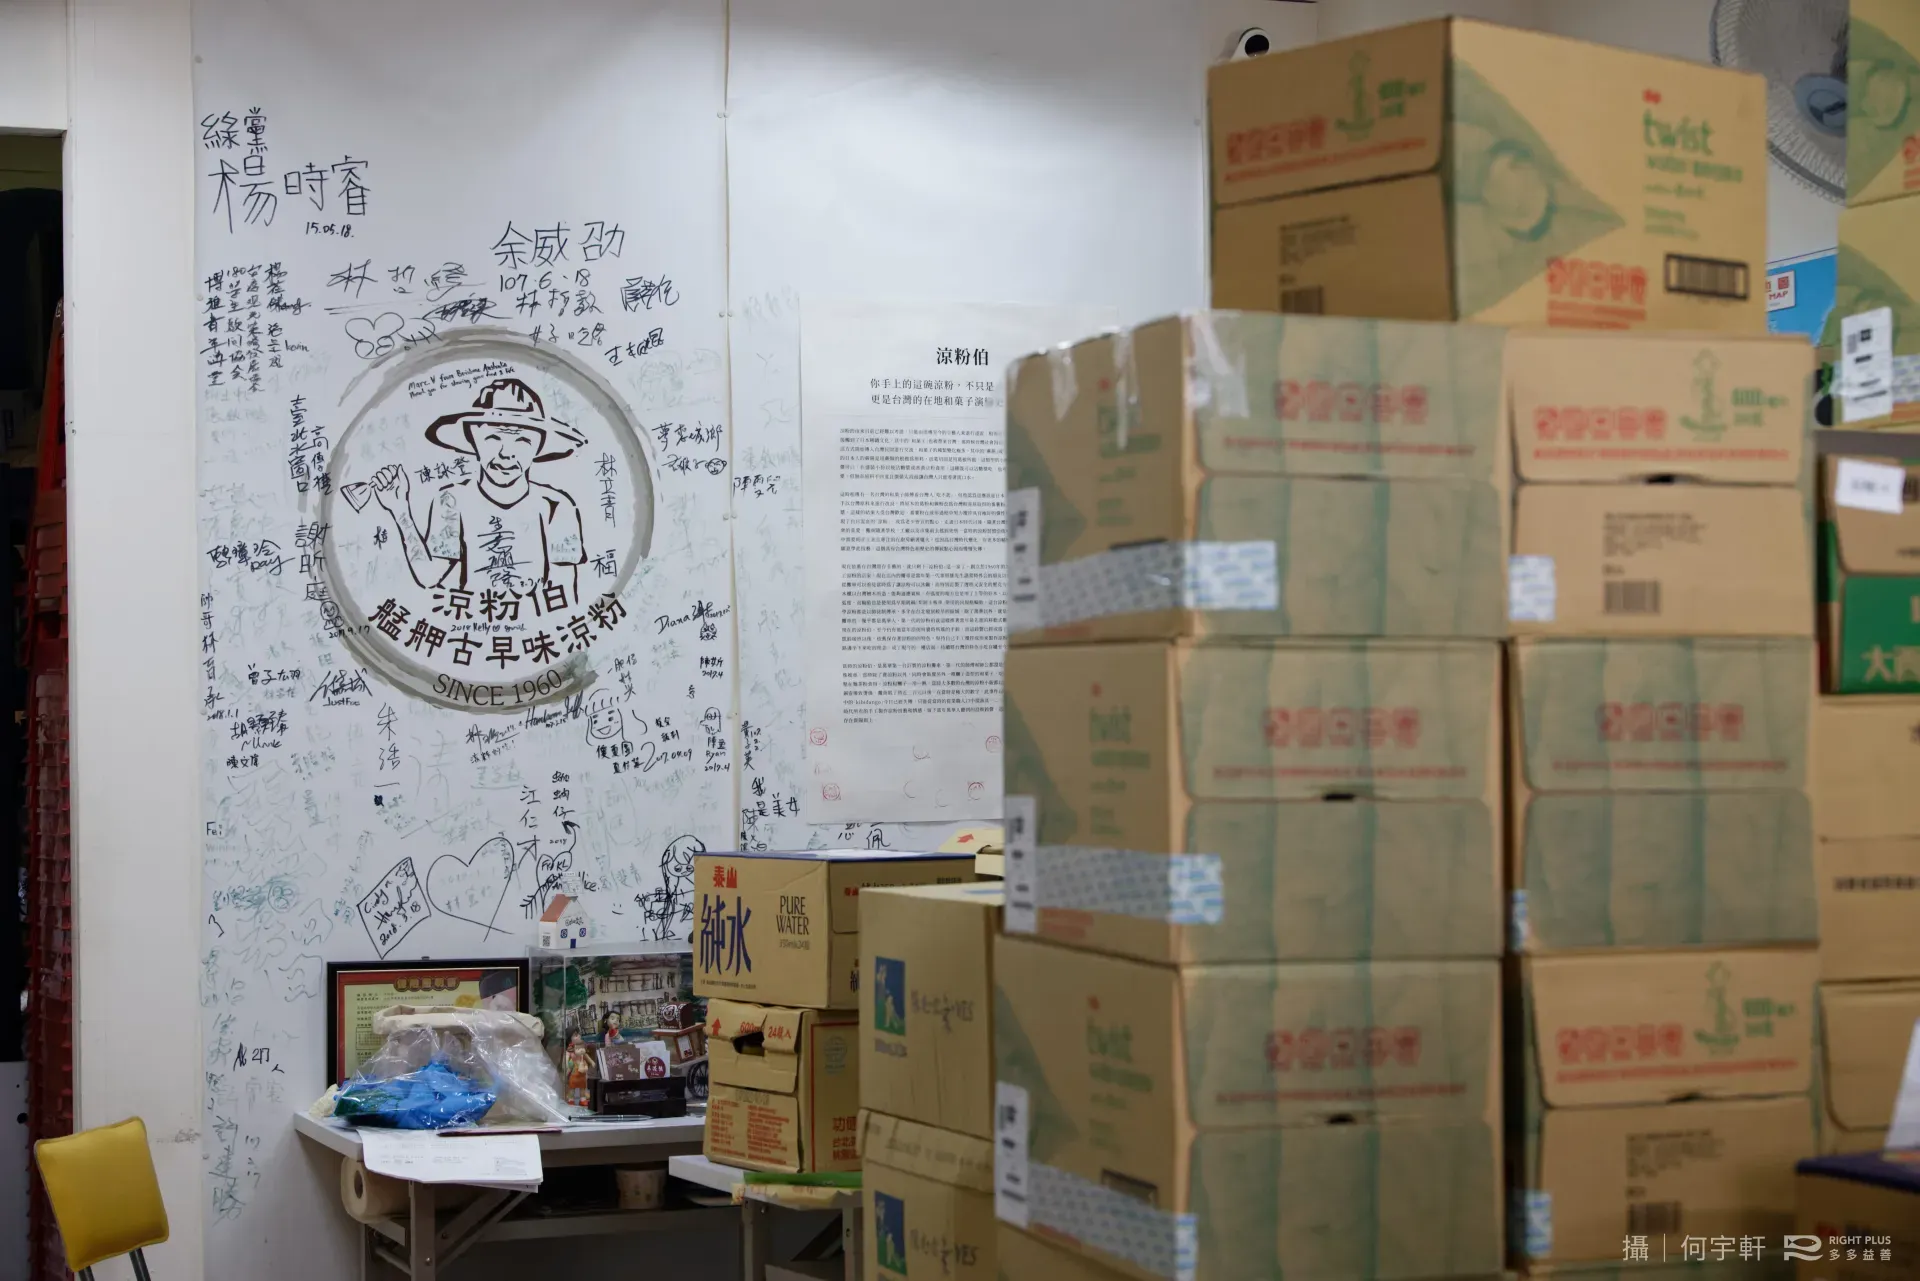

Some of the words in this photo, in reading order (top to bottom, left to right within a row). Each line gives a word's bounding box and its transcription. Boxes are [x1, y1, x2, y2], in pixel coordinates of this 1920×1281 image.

[201, 106, 268, 154] 綠黨
[208, 155, 371, 234] 楊時睿
[1768, 290, 1789, 300] MAP
[936, 346, 989, 366] 涼粉伯
[594, 452, 618, 527] 林立青
[432, 577, 568, 622] 涼粉伯
[368, 592, 627, 670] 艋舺古早味涼粉
[654, 615, 692, 635] Diana
[432, 673, 505, 707] SINCE
[512, 669, 563, 703] 1960
[712, 864, 738, 889] 泰山
[779, 895, 806, 916] PURE
[700, 893, 752, 977] 純水
[776, 915, 810, 936] WATER
